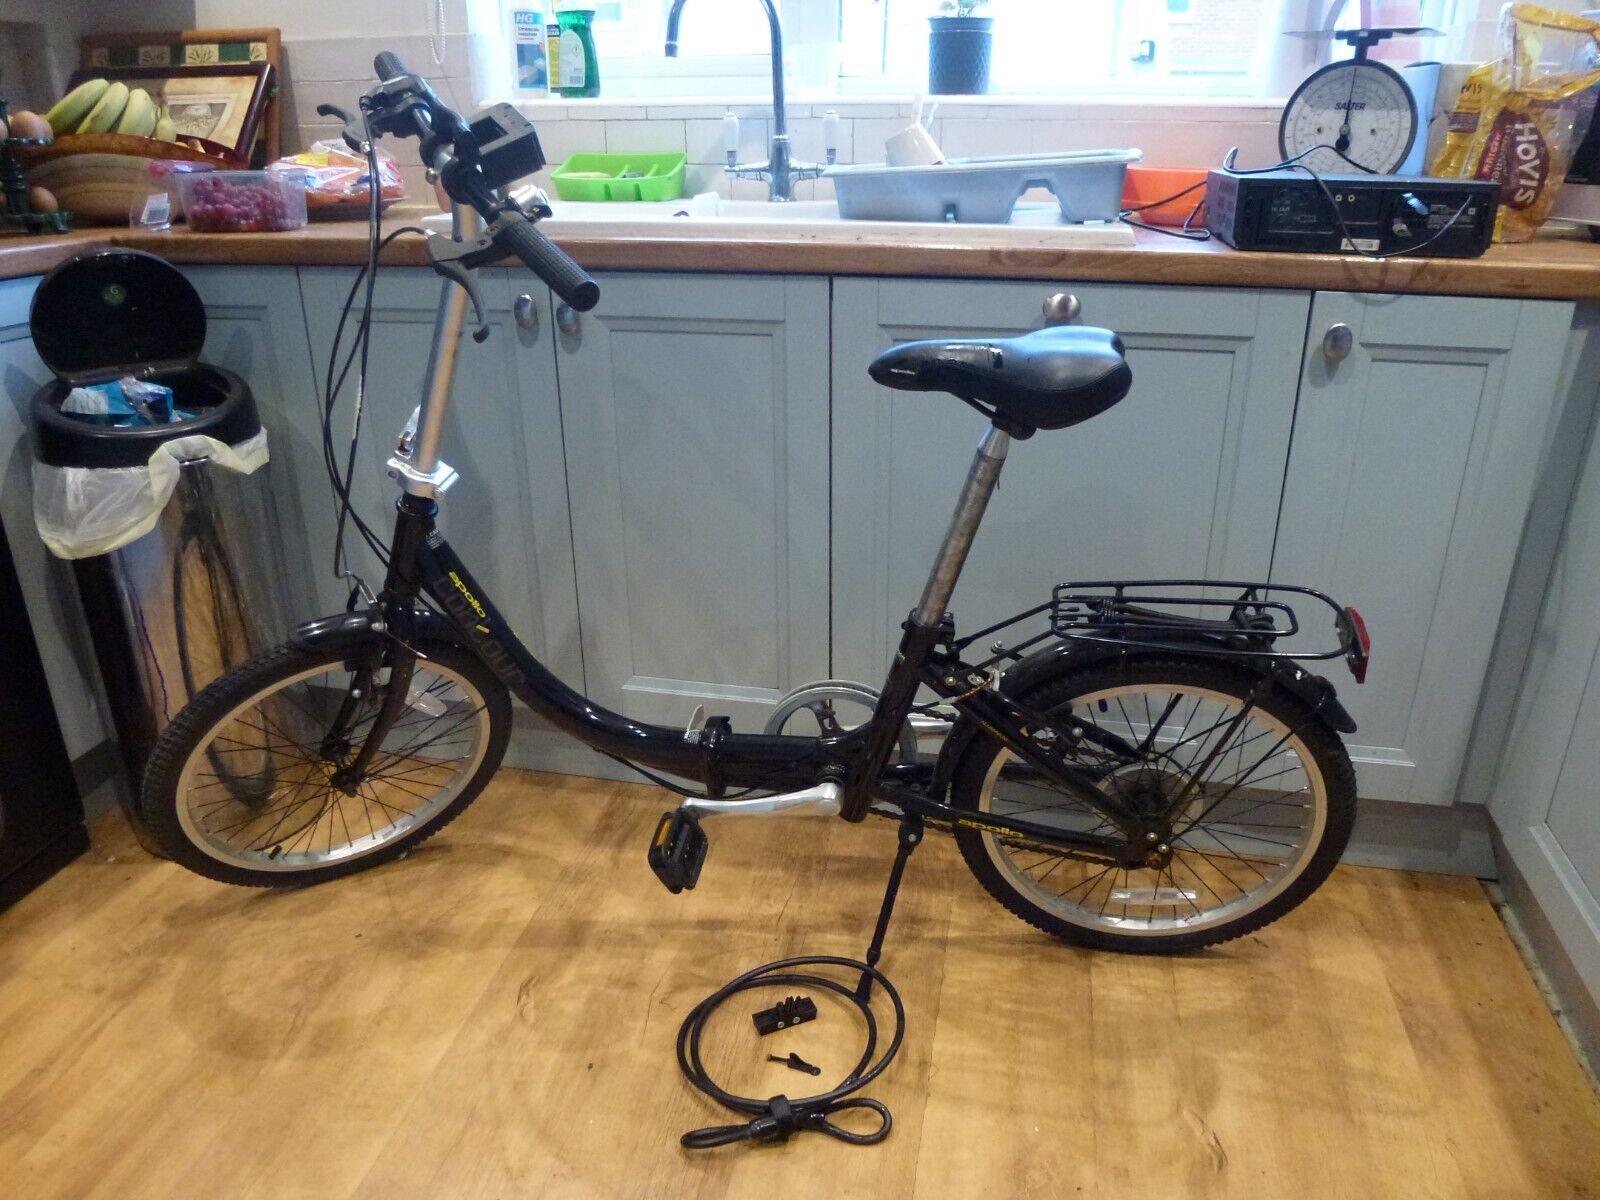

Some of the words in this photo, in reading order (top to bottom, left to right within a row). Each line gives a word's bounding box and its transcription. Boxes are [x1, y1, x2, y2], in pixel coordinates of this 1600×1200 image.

[516, 13, 533, 23] HG
[1334, 102, 1367, 111] SALTER
[1514, 122, 1541, 204] HOVIS
[449, 571, 486, 618] apollo
[958, 818, 1024, 838] apollo
